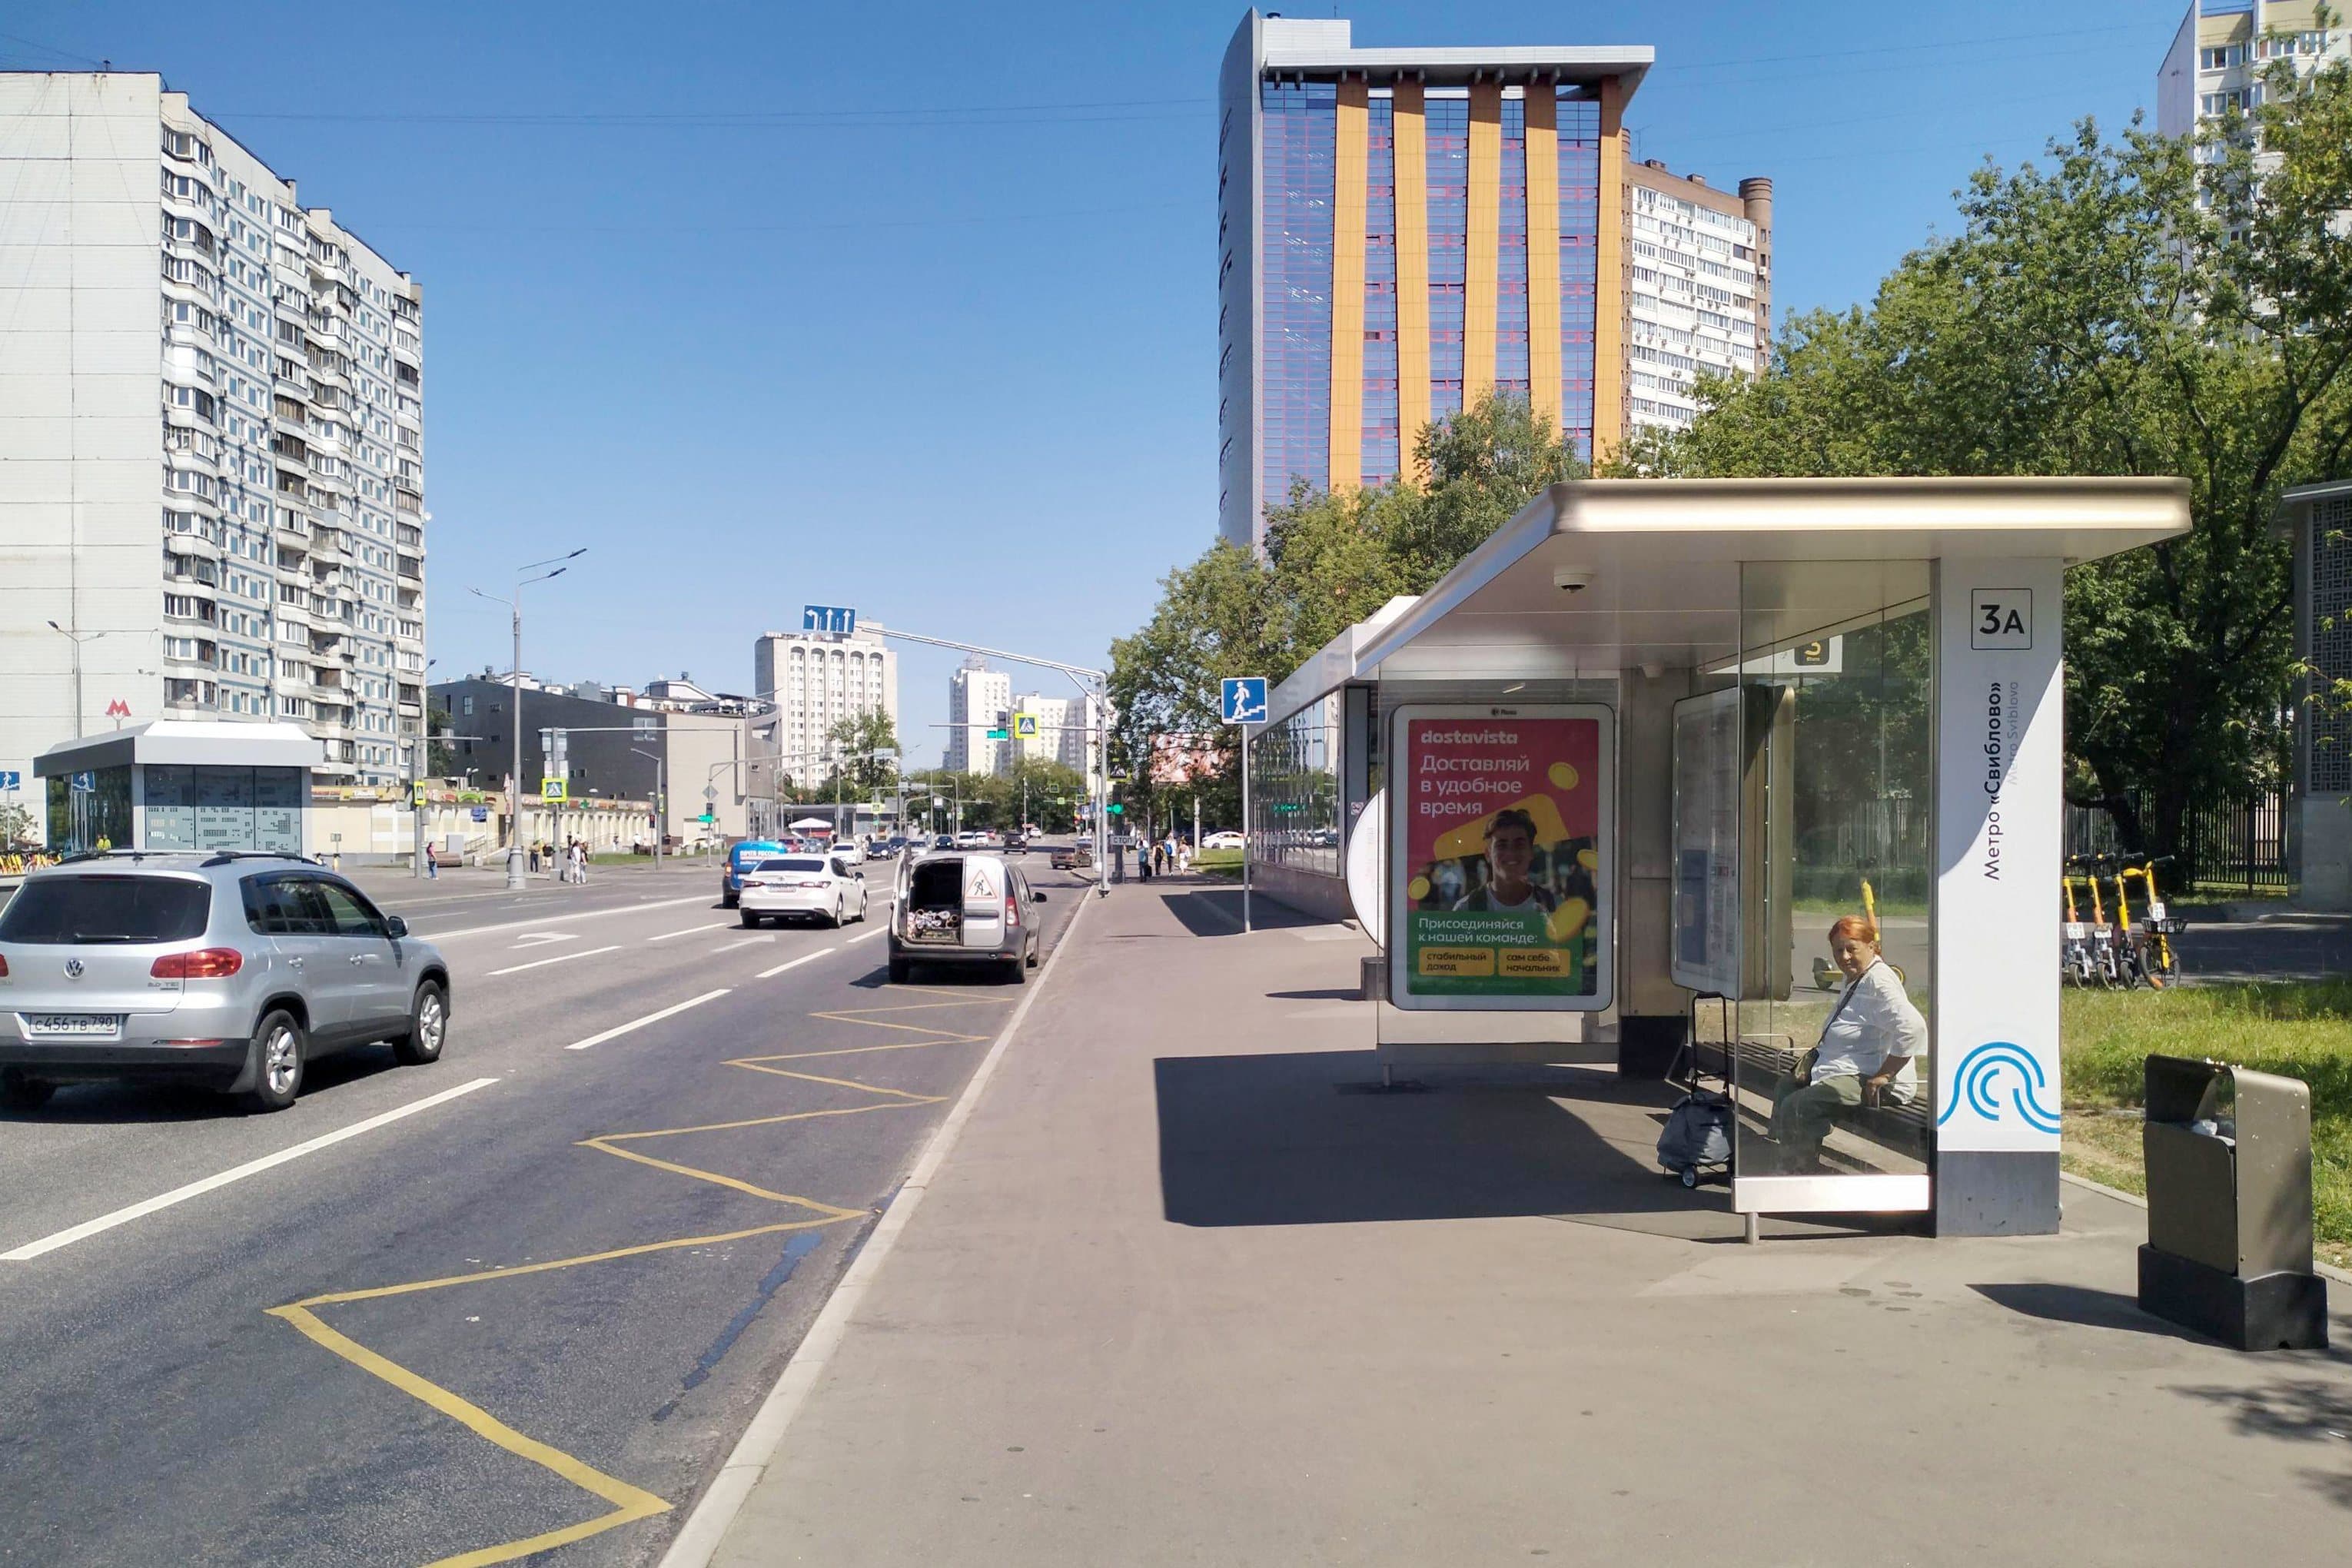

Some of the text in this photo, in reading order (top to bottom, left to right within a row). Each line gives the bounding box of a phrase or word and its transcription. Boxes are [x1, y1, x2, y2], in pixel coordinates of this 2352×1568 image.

[2007, 682, 2018, 739] Sviblovo
[1420, 729, 1518, 745] dostavista
[1420, 754, 1530, 774] Доставляй
[1420, 777, 1523, 797] в удобное
[1984, 682, 2004, 881] Метро «Свиблово»
[1420, 802, 1483, 819] время
[1418, 917, 1524, 931] Присоединяйся
[1418, 932, 1538, 945] к нашей команде:
[1427, 952, 1487, 962] стабильный
[1527, 953, 1550, 962] себе
[1427, 962, 1457, 972] доход
[1507, 964, 1560, 973] начальник
[91, 1016, 113, 1028] 790
